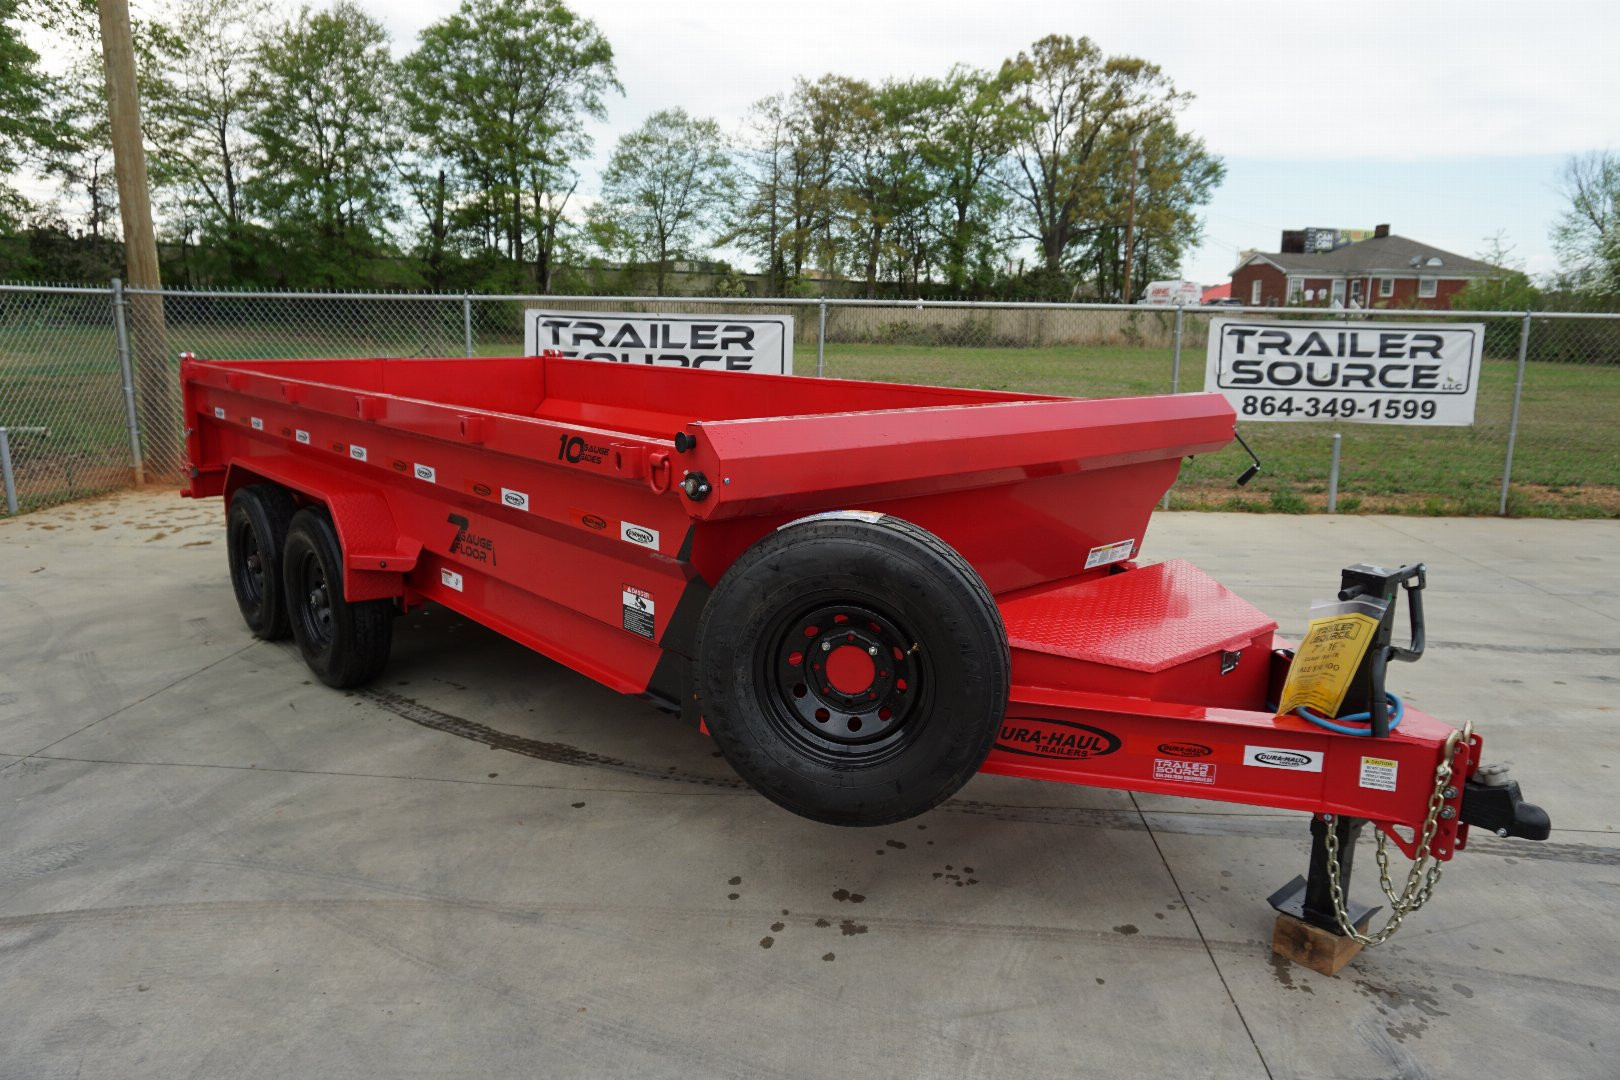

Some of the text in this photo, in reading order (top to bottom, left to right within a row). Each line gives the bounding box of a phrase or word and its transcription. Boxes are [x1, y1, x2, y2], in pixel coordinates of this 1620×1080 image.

[541, 320, 756, 351] TRAILER
[1226, 329, 1445, 360] TRAILER
[1230, 360, 1463, 391] SOURCE LLC
[1241, 395, 1437, 420] 864-349-1599
[558, 434, 609, 464] 10 GAUGE
[447, 513, 493, 554] 7 GAUGE
[999, 727, 1102, 751] URA-HAUL
[1035, 744, 1088, 757] TRAILERS
[1155, 760, 1209, 772] TRAILER
[1261, 754, 1305, 764] DURA-HAUL
[1156, 767, 1208, 777] SOURCE
